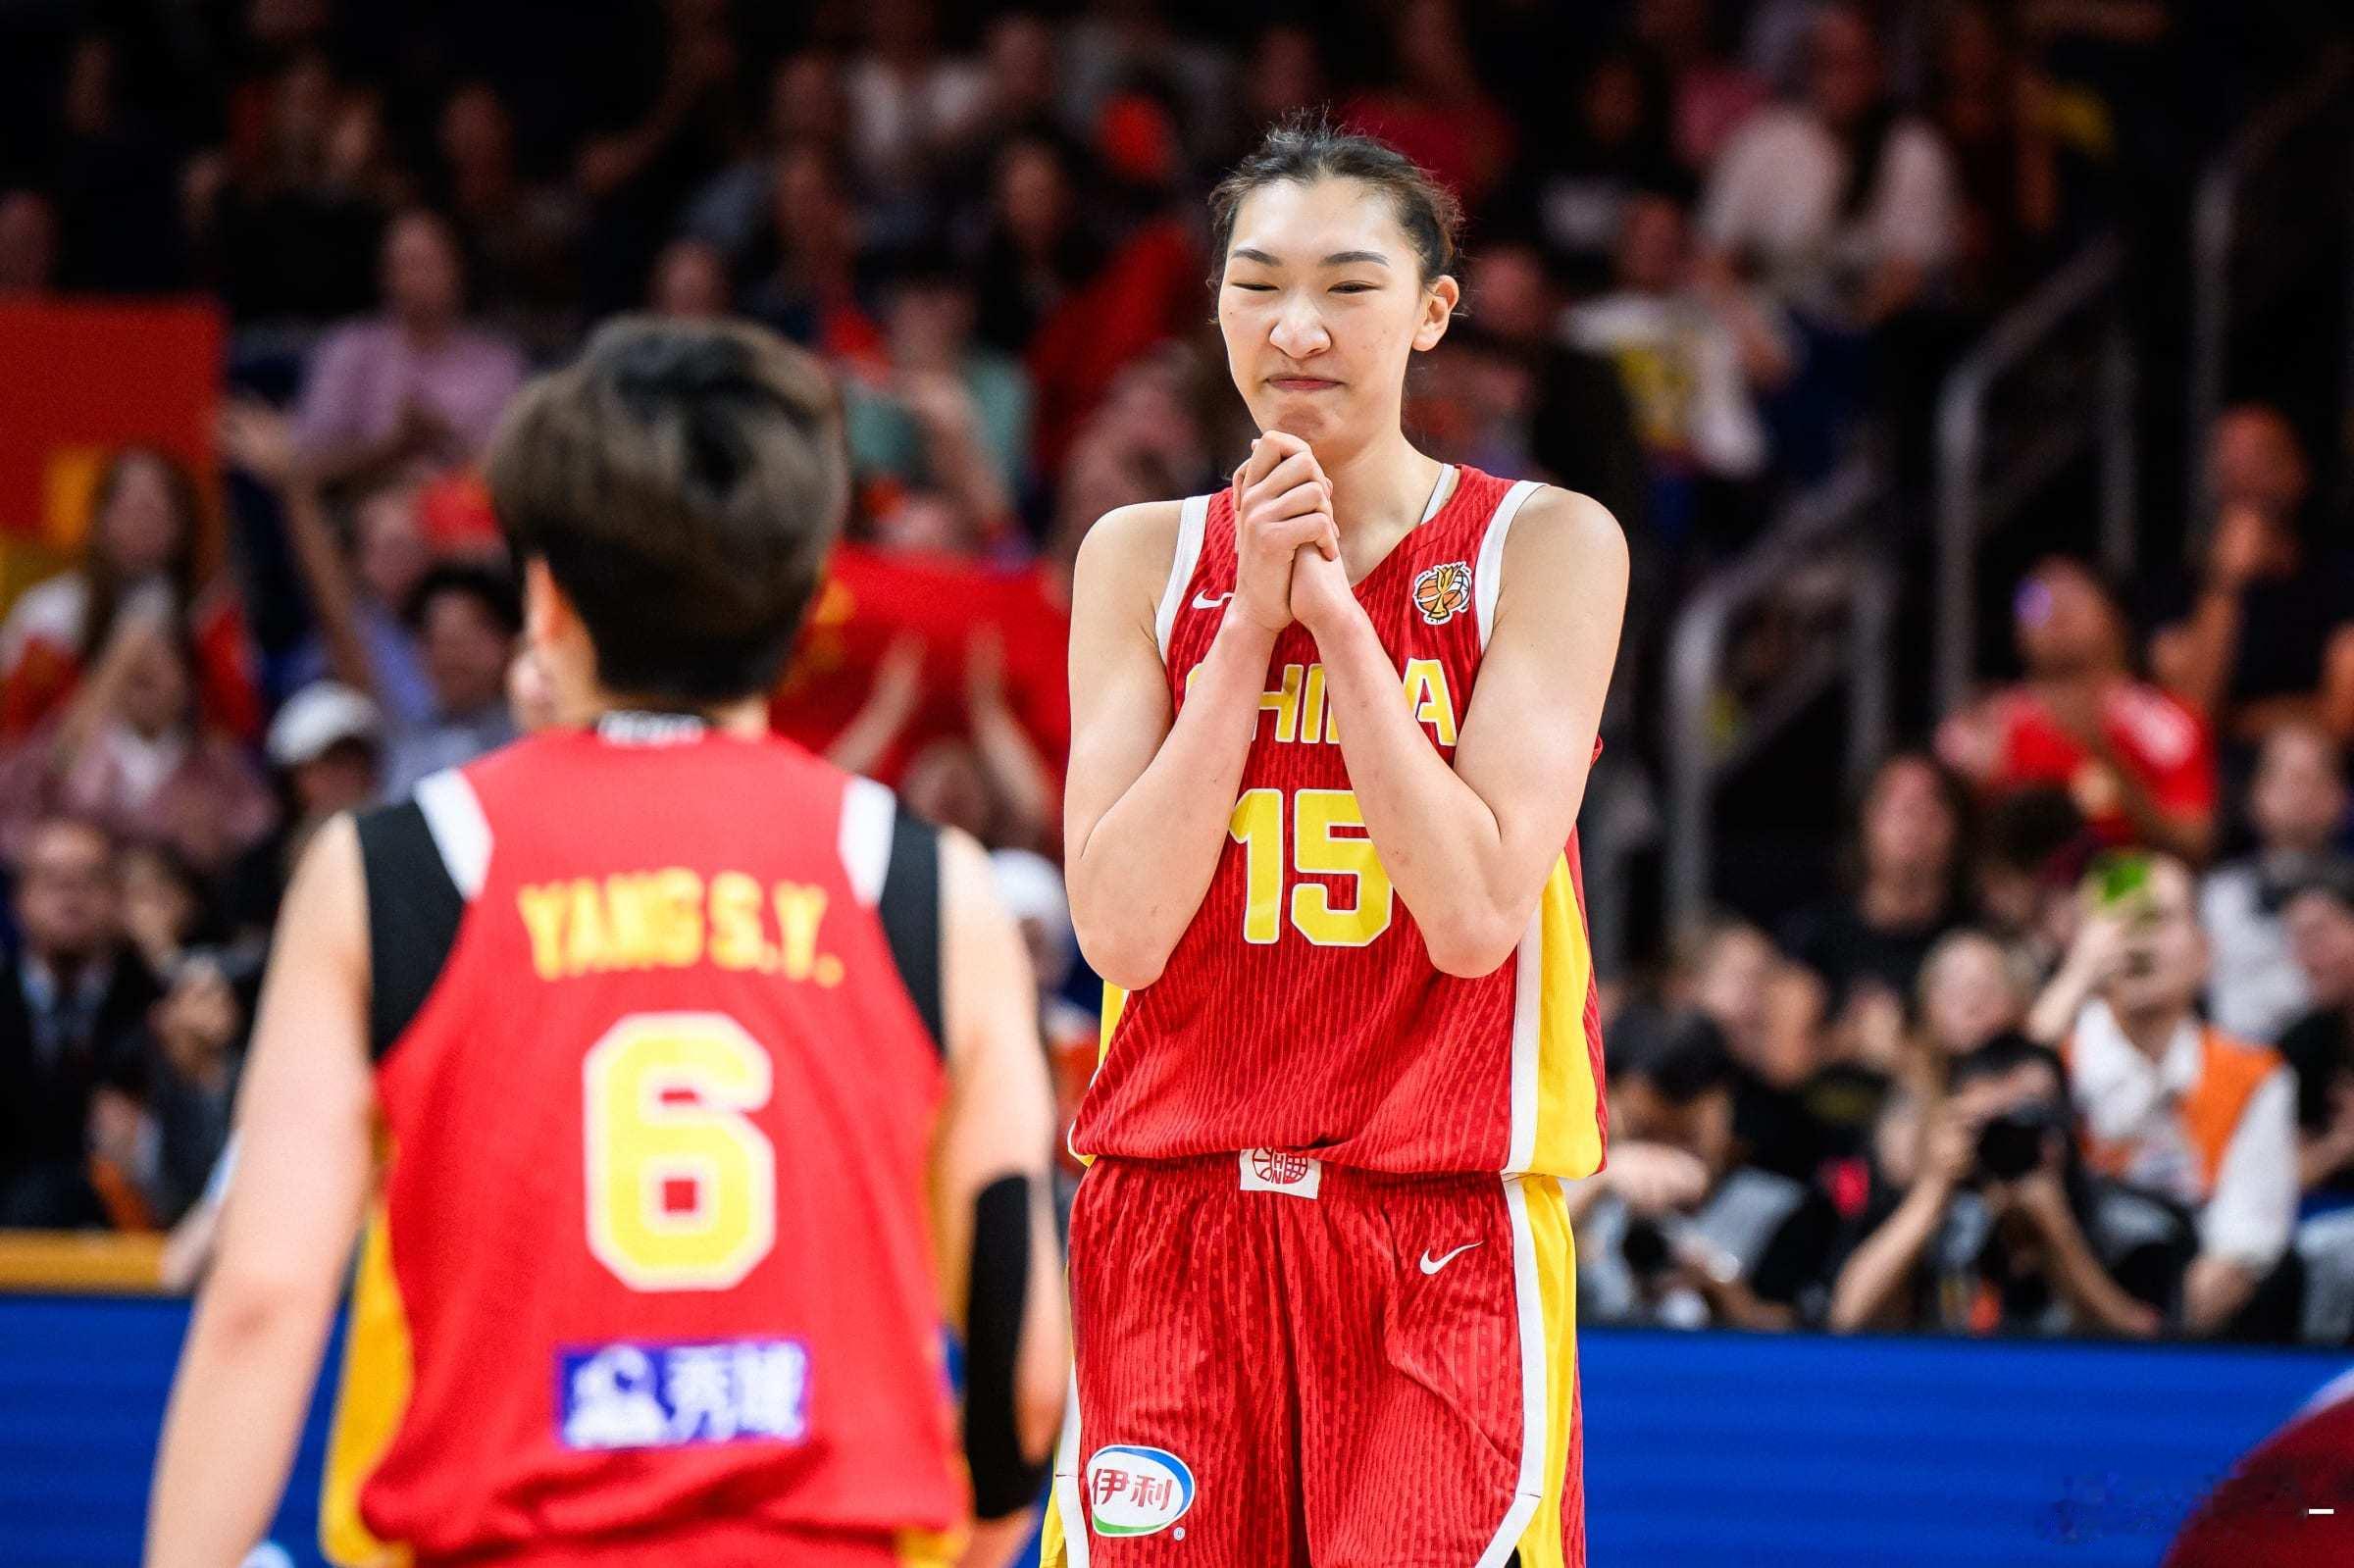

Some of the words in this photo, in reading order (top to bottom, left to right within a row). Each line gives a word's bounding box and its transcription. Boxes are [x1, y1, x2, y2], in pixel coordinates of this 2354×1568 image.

[1185, 658, 1458, 746] HIA
[1228, 787, 1394, 946] 15
[582, 1010, 777, 1291] 6
[1092, 1468, 1173, 1511] 伊利
